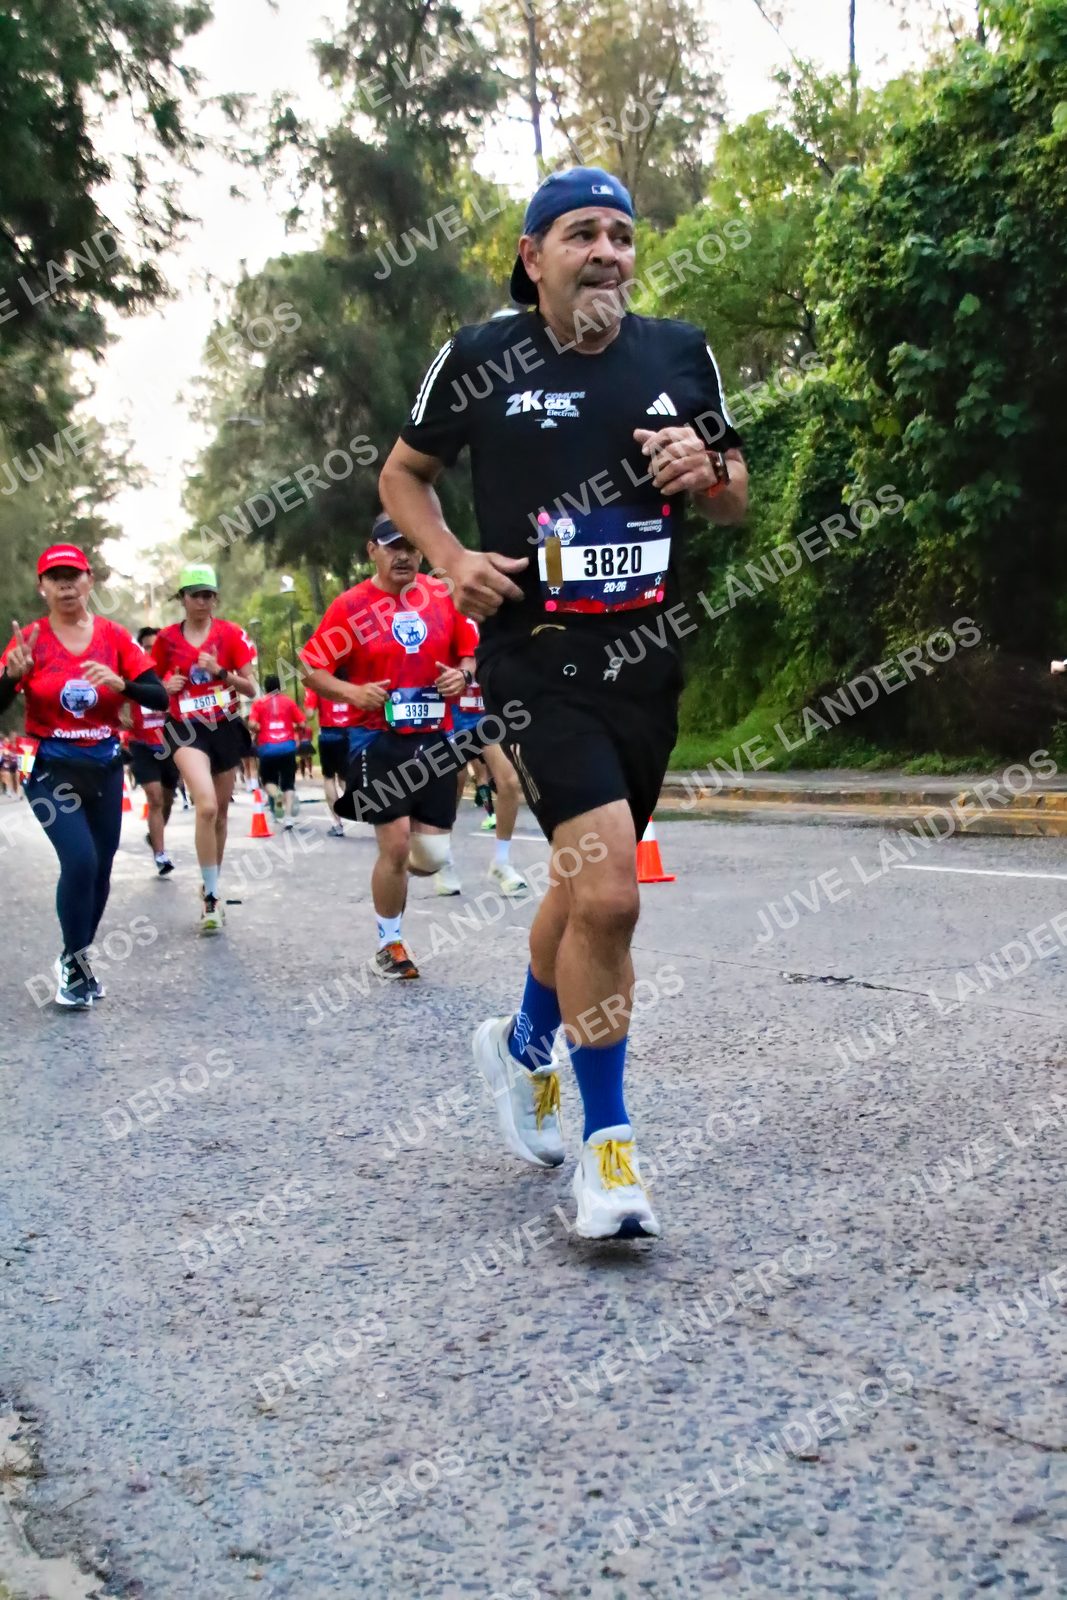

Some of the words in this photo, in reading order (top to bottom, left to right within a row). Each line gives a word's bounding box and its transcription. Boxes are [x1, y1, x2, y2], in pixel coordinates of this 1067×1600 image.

[583, 545, 642, 577] 3820
[603, 580, 628, 593] 20-26
[193, 695, 217, 709] 2503
[405, 704, 429, 717] 3839
